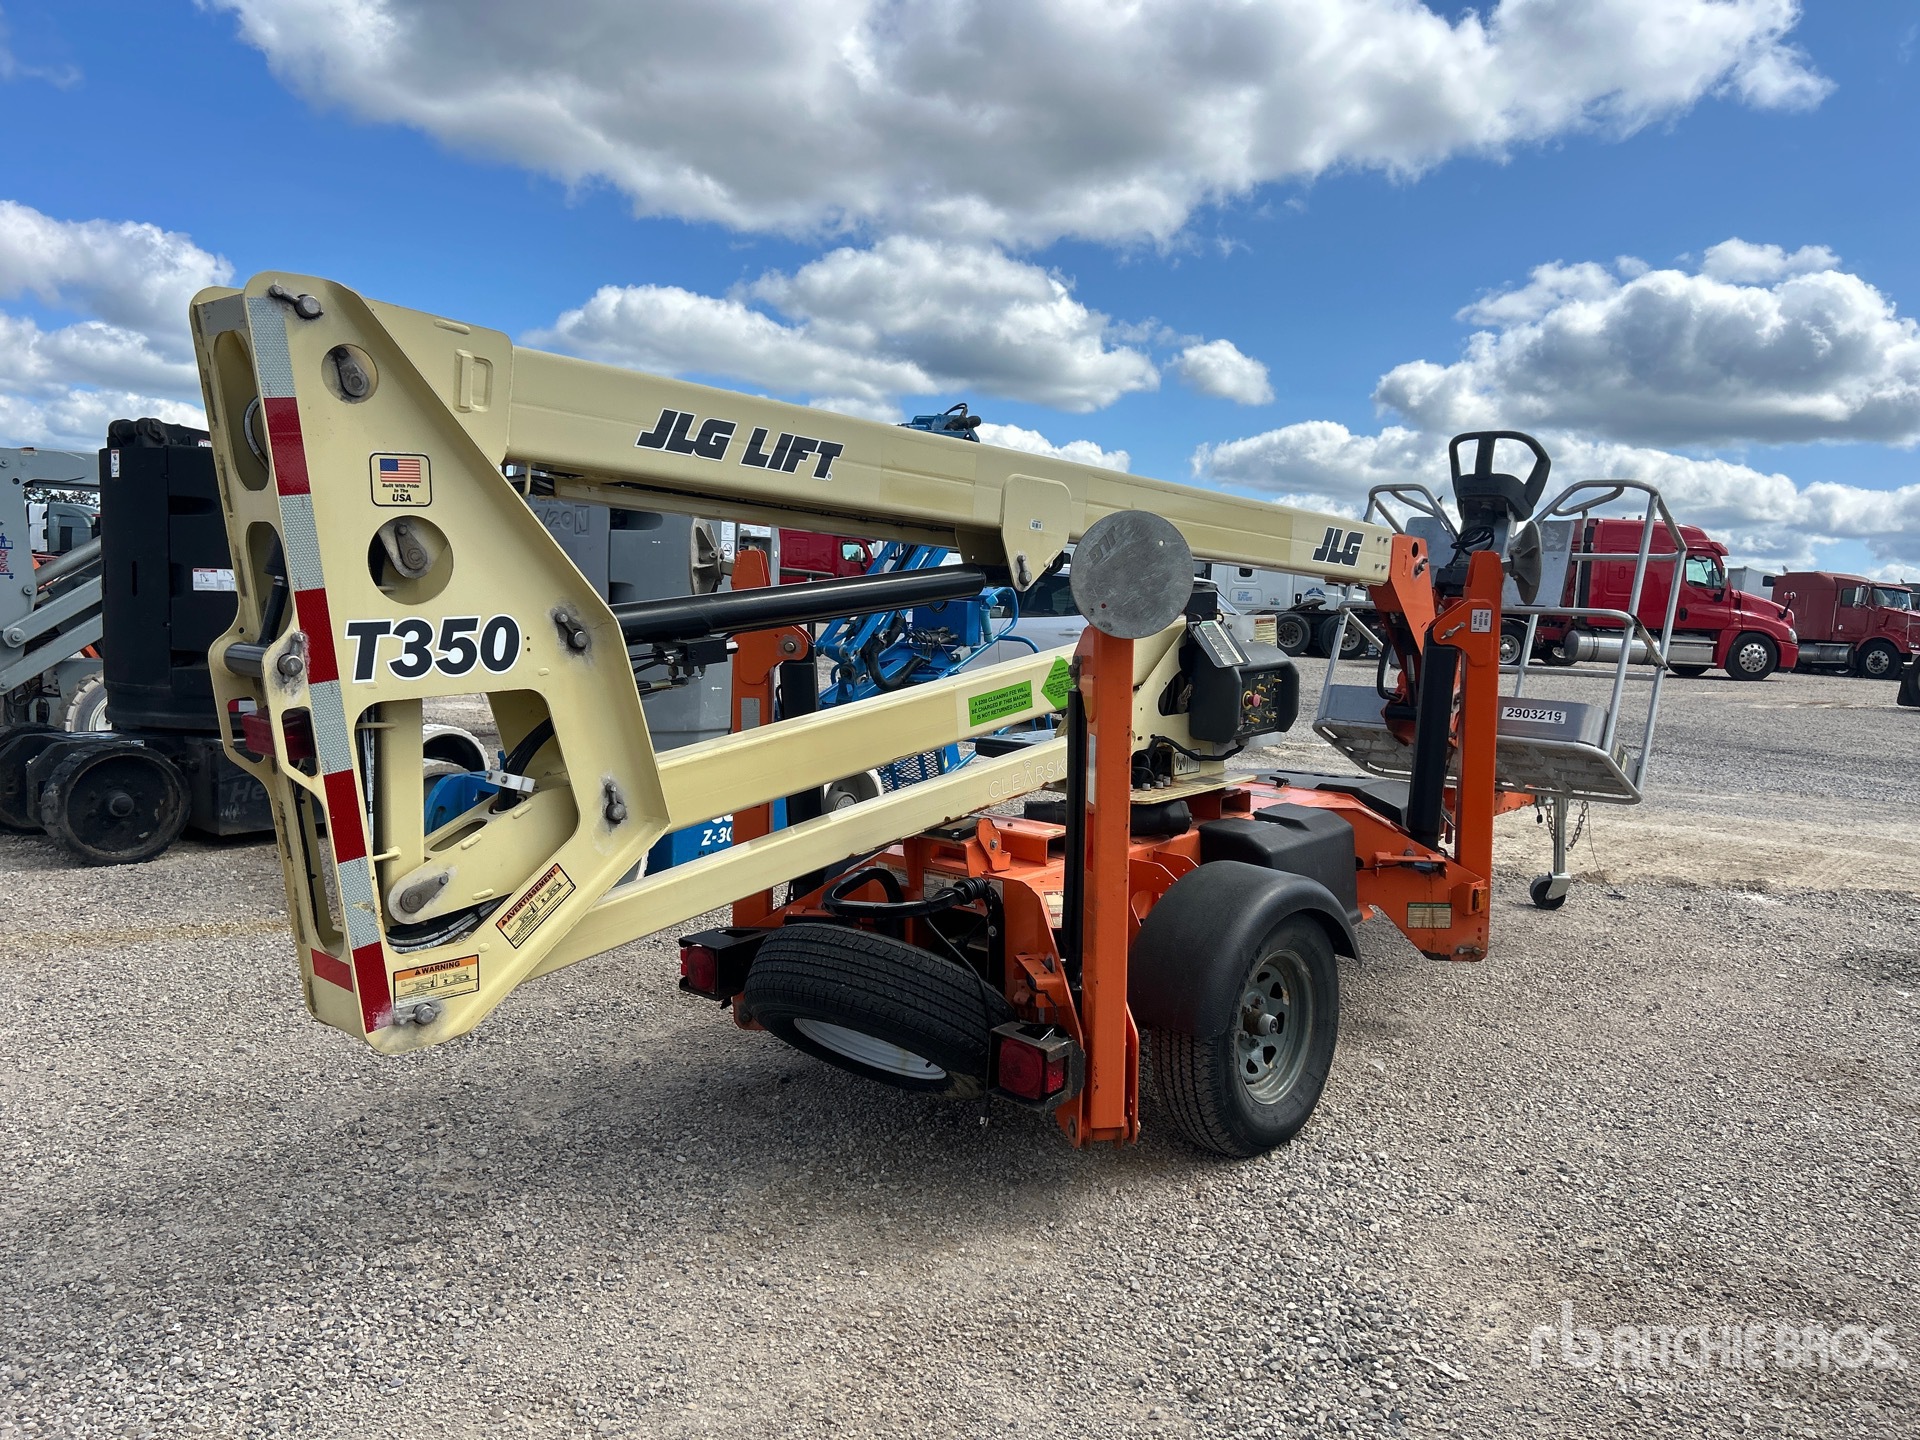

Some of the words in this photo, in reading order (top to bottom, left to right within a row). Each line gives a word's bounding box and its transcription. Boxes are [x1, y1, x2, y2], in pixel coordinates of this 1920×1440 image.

[634, 408, 738, 462] JLG
[739, 427, 844, 480] LIFT
[392, 493, 412, 502] USA
[1311, 526, 1364, 567] JLG
[345, 614, 521, 683] T350
[977, 702, 999, 713] CHARGED
[1012, 692, 1031, 704] MACHINE
[988, 691, 1009, 704] CLEANING
[1008, 689, 1017, 697] FEE
[1016, 687, 1028, 695] WILL
[981, 711, 991, 719] NOT
[990, 705, 1011, 717] RETURNED
[1010, 701, 1027, 710] CLEAN
[1506, 707, 1562, 721] 2903219
[989, 758, 1066, 798] CLEARSK
[229, 779, 266, 803] He
[506, 869, 557, 921] AVERTISSEMENT
[421, 961, 461, 974] WARNING
